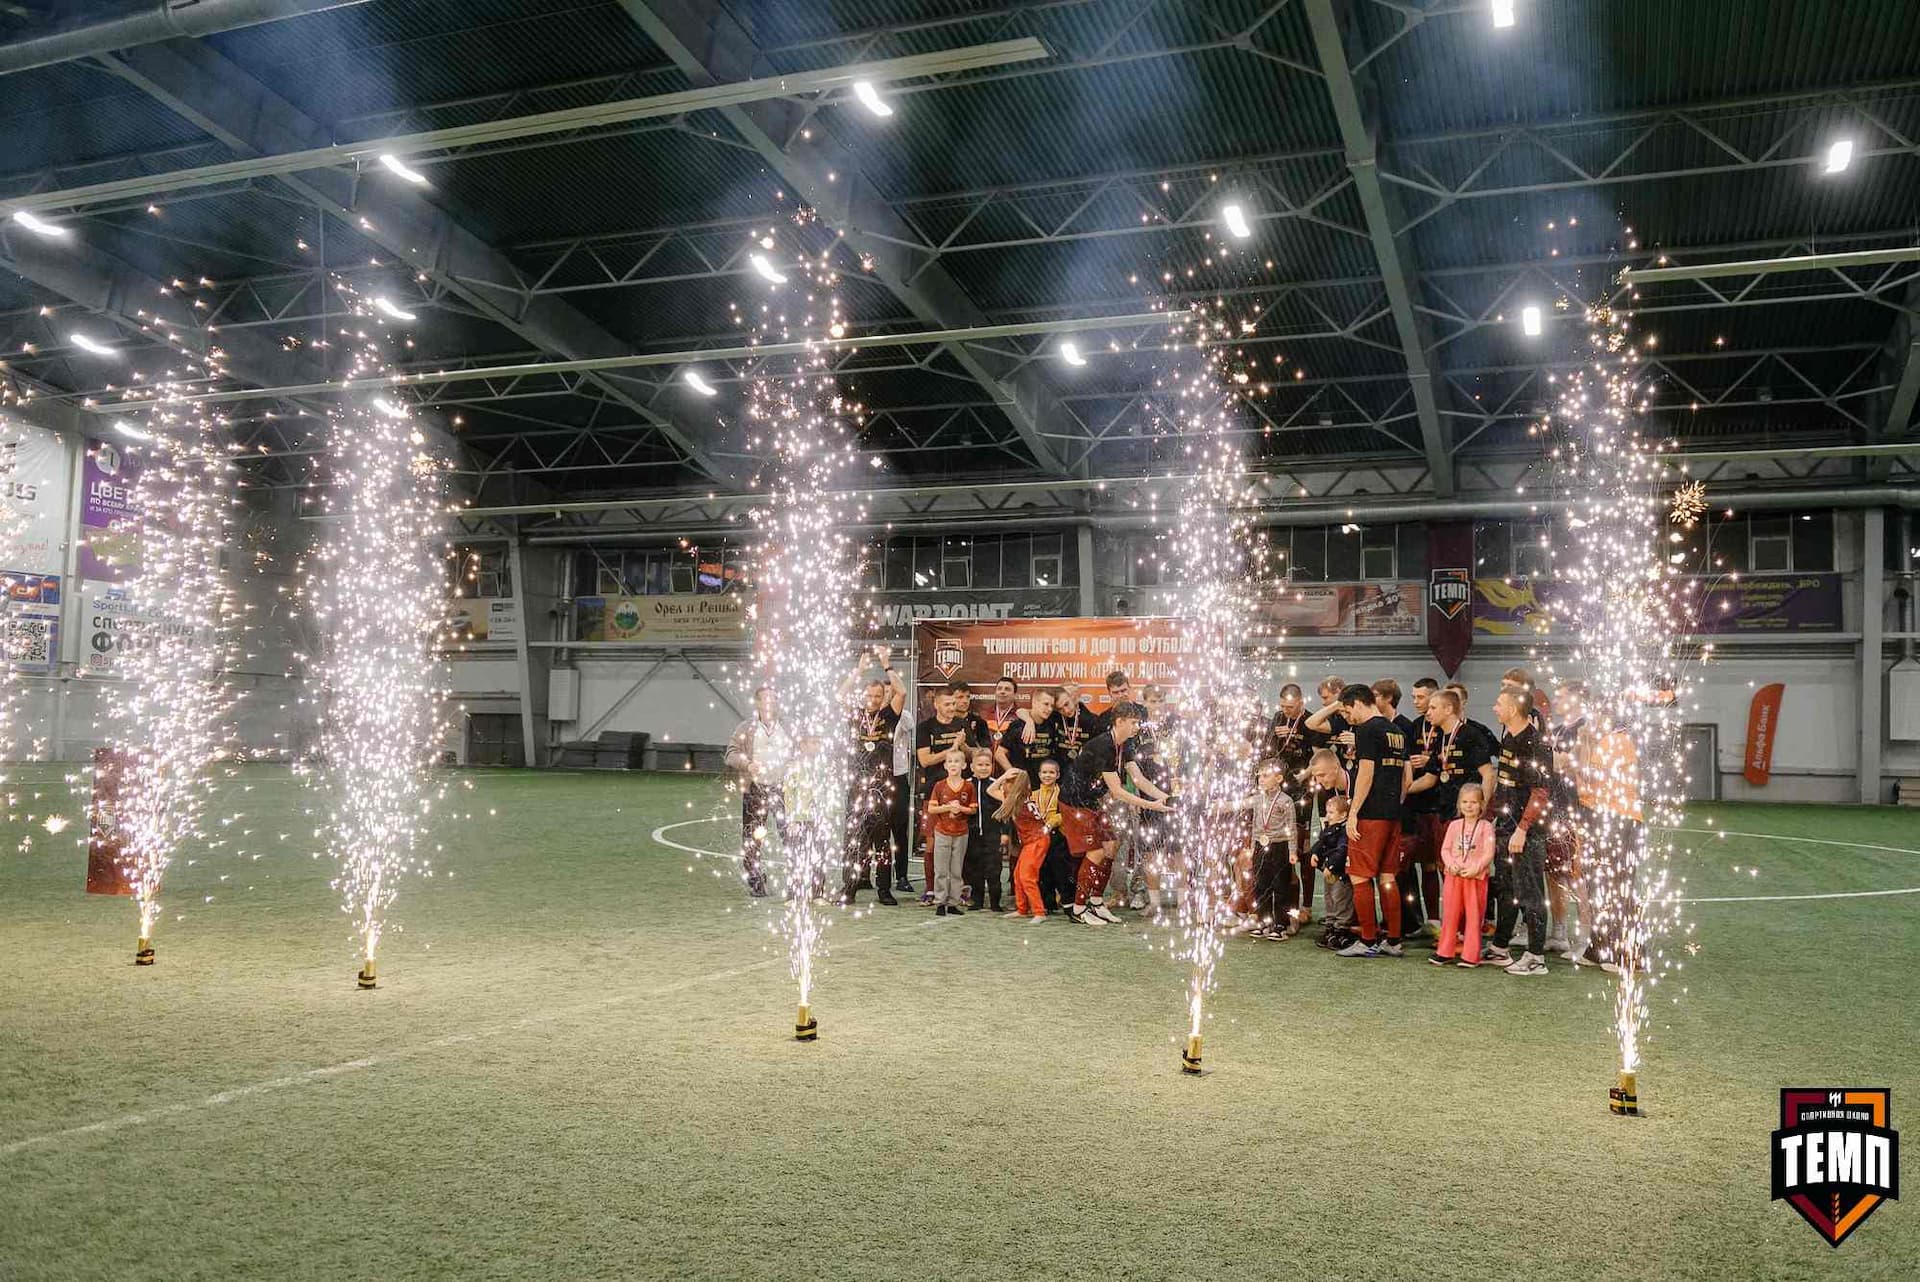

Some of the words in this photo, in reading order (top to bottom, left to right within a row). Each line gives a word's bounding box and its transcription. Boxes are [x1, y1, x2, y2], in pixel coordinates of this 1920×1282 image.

[1434, 583, 1466, 600] ТЕМП
[874, 603, 1014, 626] WARPOINT
[983, 638, 1049, 654] ЧЕМПИОНАТ
[1052, 638, 1076, 654] СФО
[1080, 637, 1087, 653] И
[1091, 637, 1116, 656] ДФО
[1120, 637, 1136, 653] ПО
[937, 650, 960, 664] ТЕМП
[1003, 662, 1037, 680] СРЕДИ
[1041, 662, 1087, 679] МУЖЧИН
